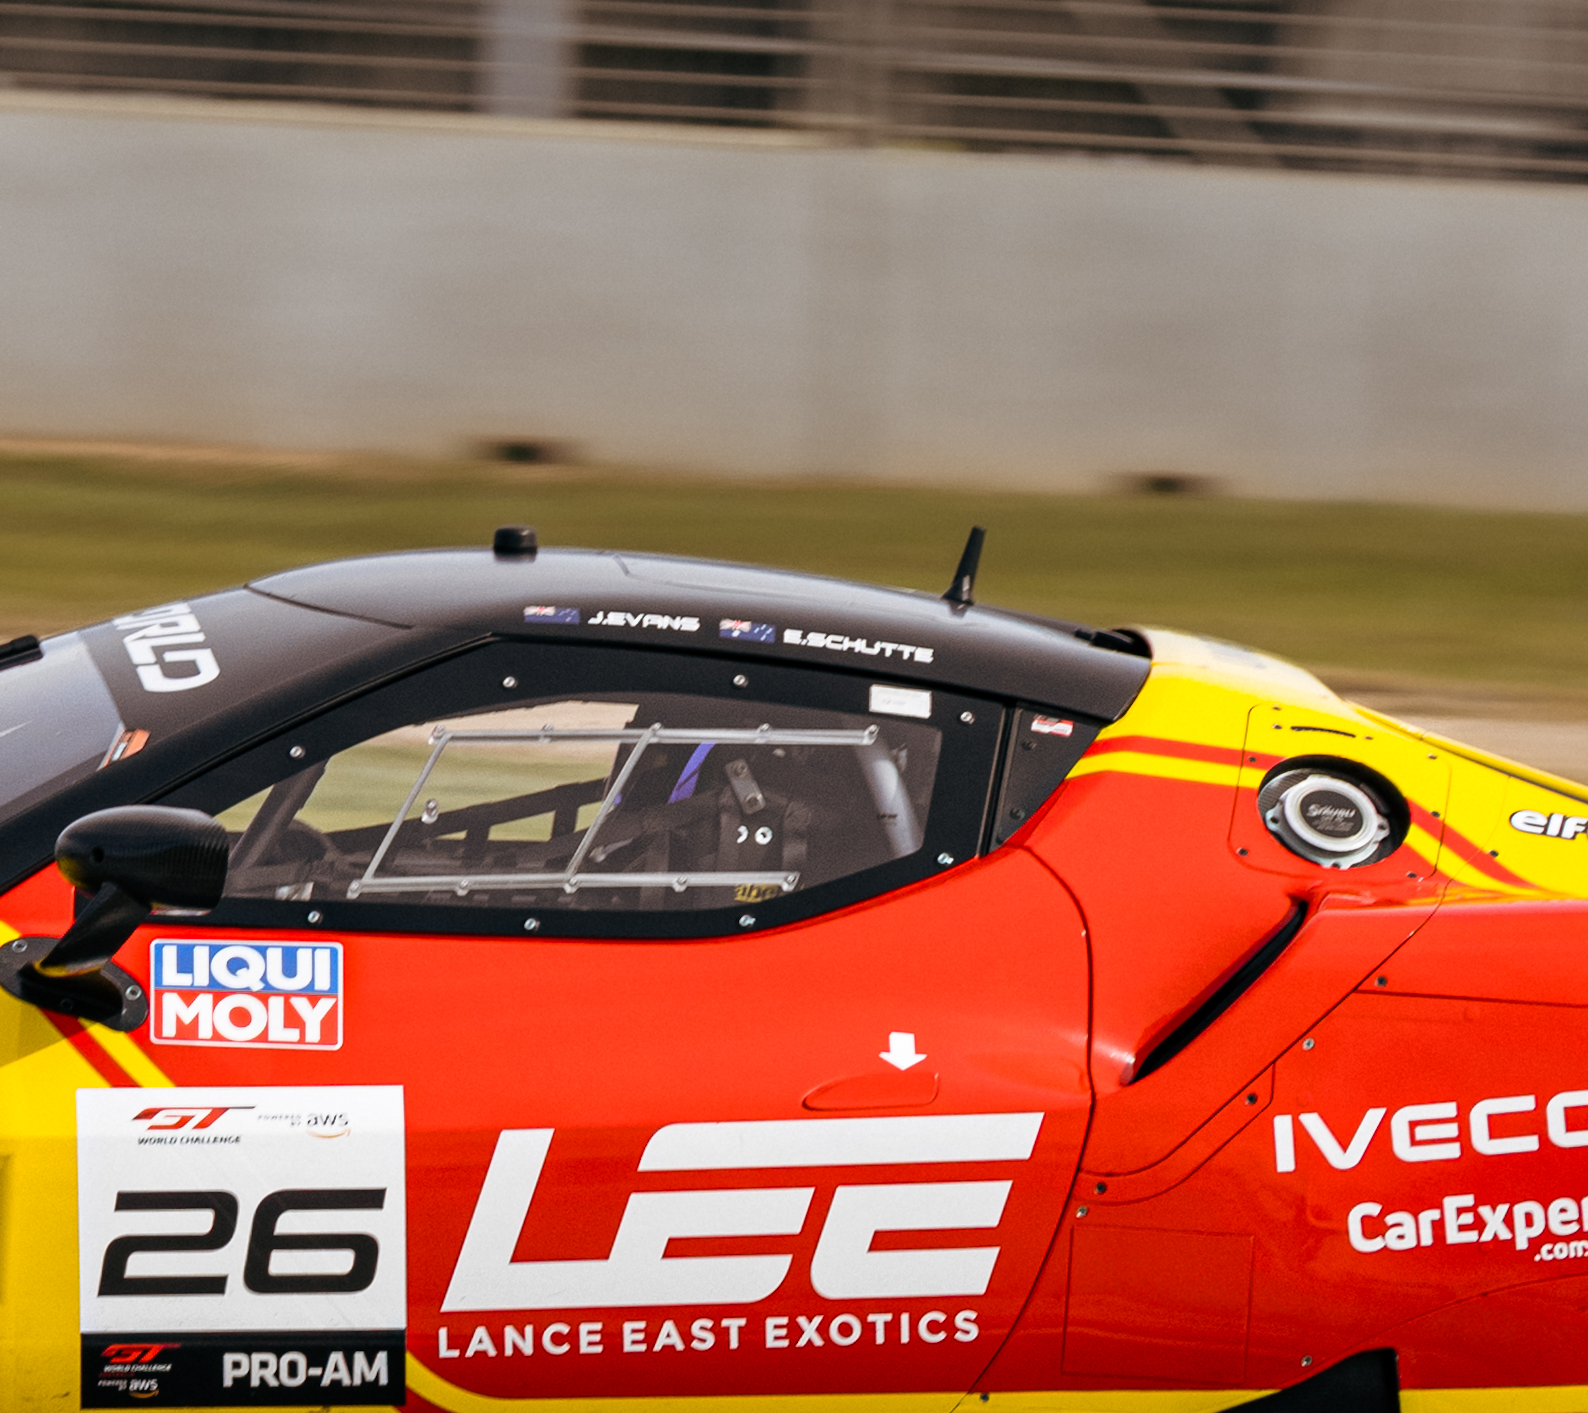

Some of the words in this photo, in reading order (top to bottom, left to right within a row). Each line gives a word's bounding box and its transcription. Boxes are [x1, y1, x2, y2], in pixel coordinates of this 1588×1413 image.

[588, 610, 701, 632] J.EVANS
[783, 628, 934, 664] E.SCHUTTE
[162, 945, 331, 992] LIQUI
[162, 992, 337, 1043] MOLY
[307, 1113, 349, 1126] aws
[440, 1112, 1045, 1312] LEE
[97, 1187, 387, 1297] 26
[438, 1321, 604, 1359] LANCE
[622, 1317, 747, 1351] EAST
[765, 1310, 980, 1349] EXOTICS
[223, 1351, 389, 1387] PRO-AM
